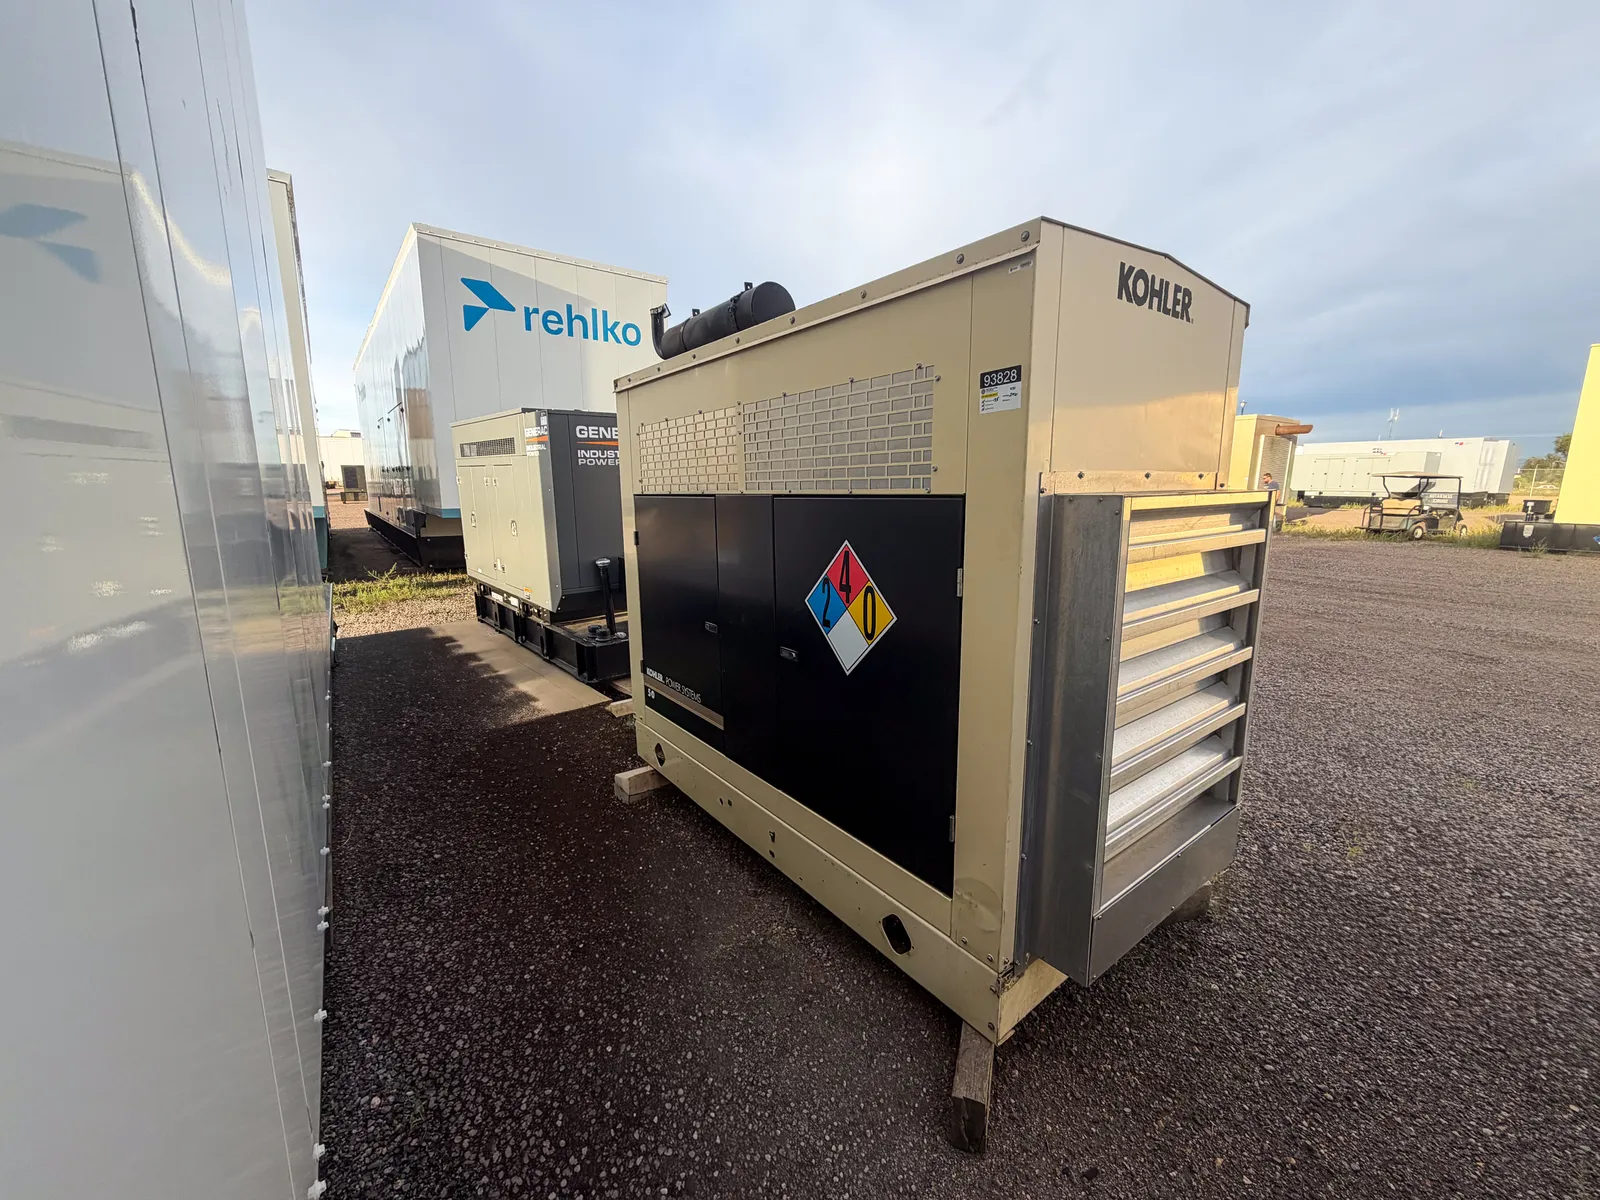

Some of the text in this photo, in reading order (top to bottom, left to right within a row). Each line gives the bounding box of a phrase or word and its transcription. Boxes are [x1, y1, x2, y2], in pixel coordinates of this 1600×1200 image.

[1117, 261, 1193, 324] KOHLER
[523, 303, 642, 347] rehlko
[983, 369, 1018, 387] 93828
[821, 577, 831, 629] 2
[839, 550, 852, 604] 4
[863, 585, 876, 641] 0
[646, 667, 702, 704] KOHLER POWER SYSTEMS
